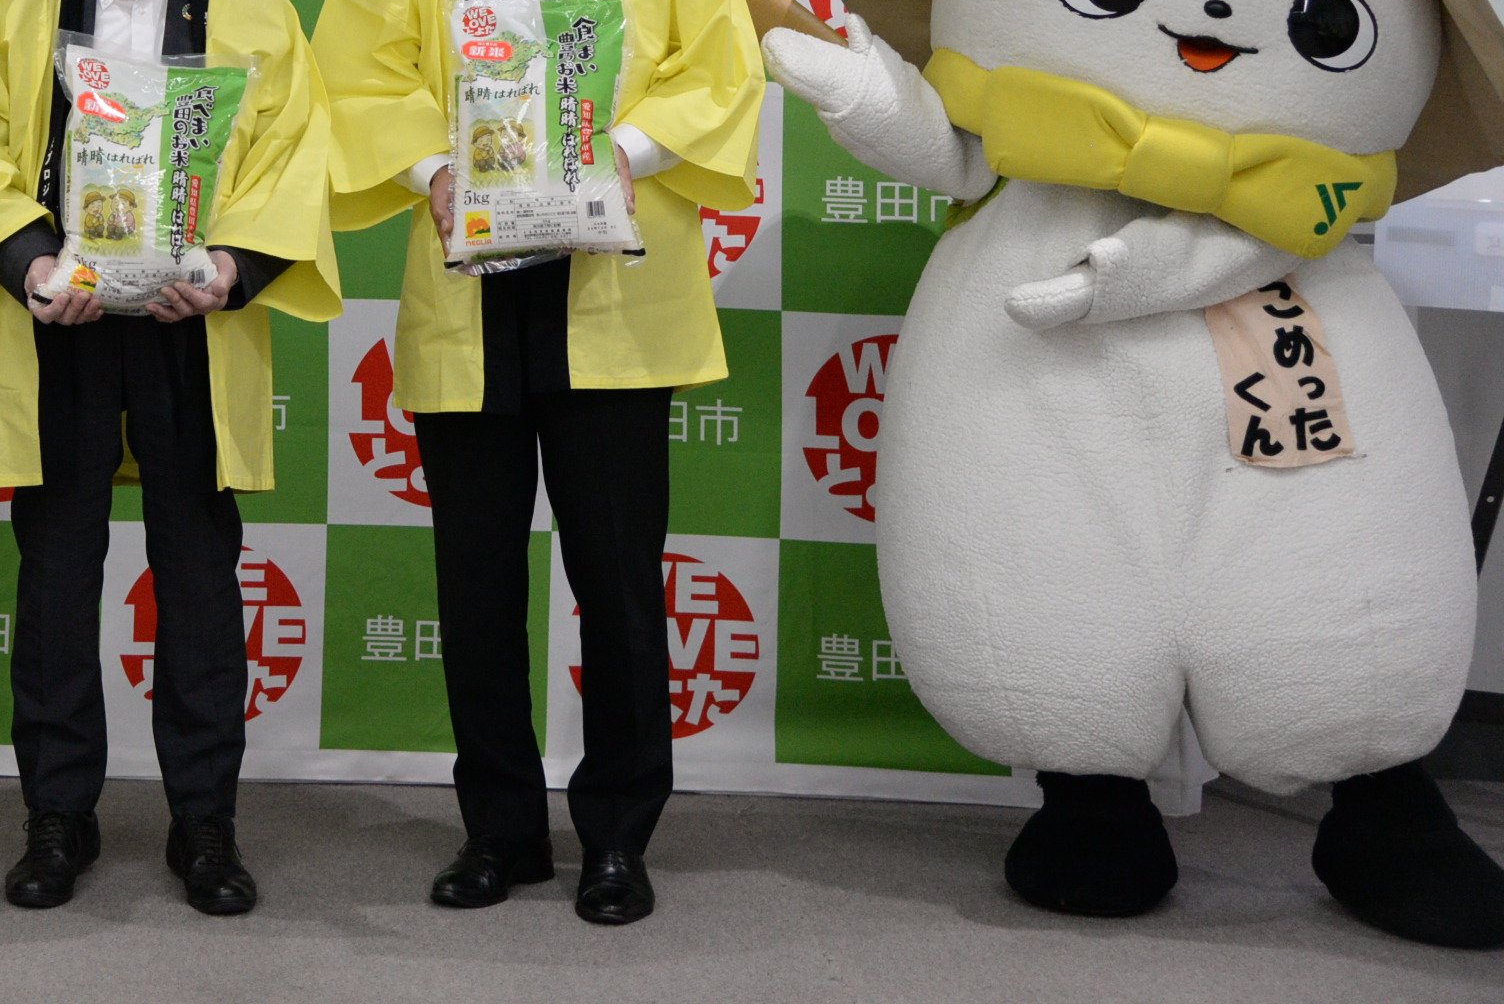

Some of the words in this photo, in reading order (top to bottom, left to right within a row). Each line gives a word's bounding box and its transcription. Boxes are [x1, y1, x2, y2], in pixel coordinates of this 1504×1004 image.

[466, 7, 488, 19] WE
[82, 61, 102, 72] WE
[468, 46, 505, 58] 新米
[464, 189, 490, 205] 5kg
[1257, 281, 1342, 452] こめった
[1233, 372, 1284, 457] くん
[360, 614, 442, 661] 豊田
[816, 634, 908, 682] 豊田
